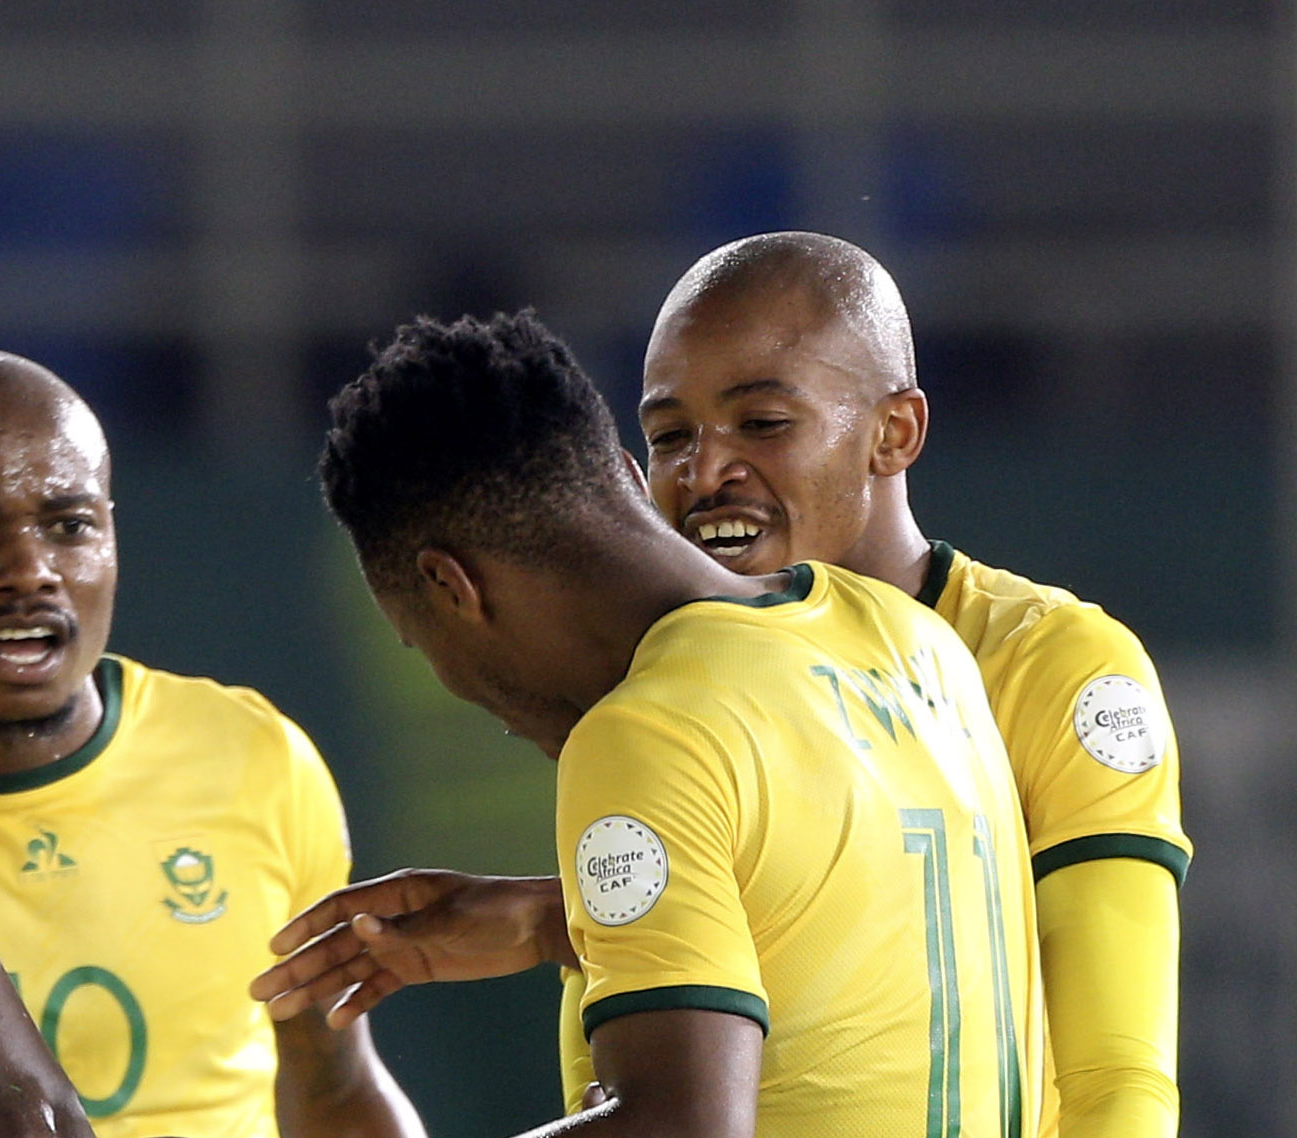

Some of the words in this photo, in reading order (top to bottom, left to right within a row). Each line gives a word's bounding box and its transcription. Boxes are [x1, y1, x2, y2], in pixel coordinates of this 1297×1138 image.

[1116, 727, 1147, 742] CAF
[587, 850, 644, 877] Celebrate
[599, 876, 633, 893] CAF
